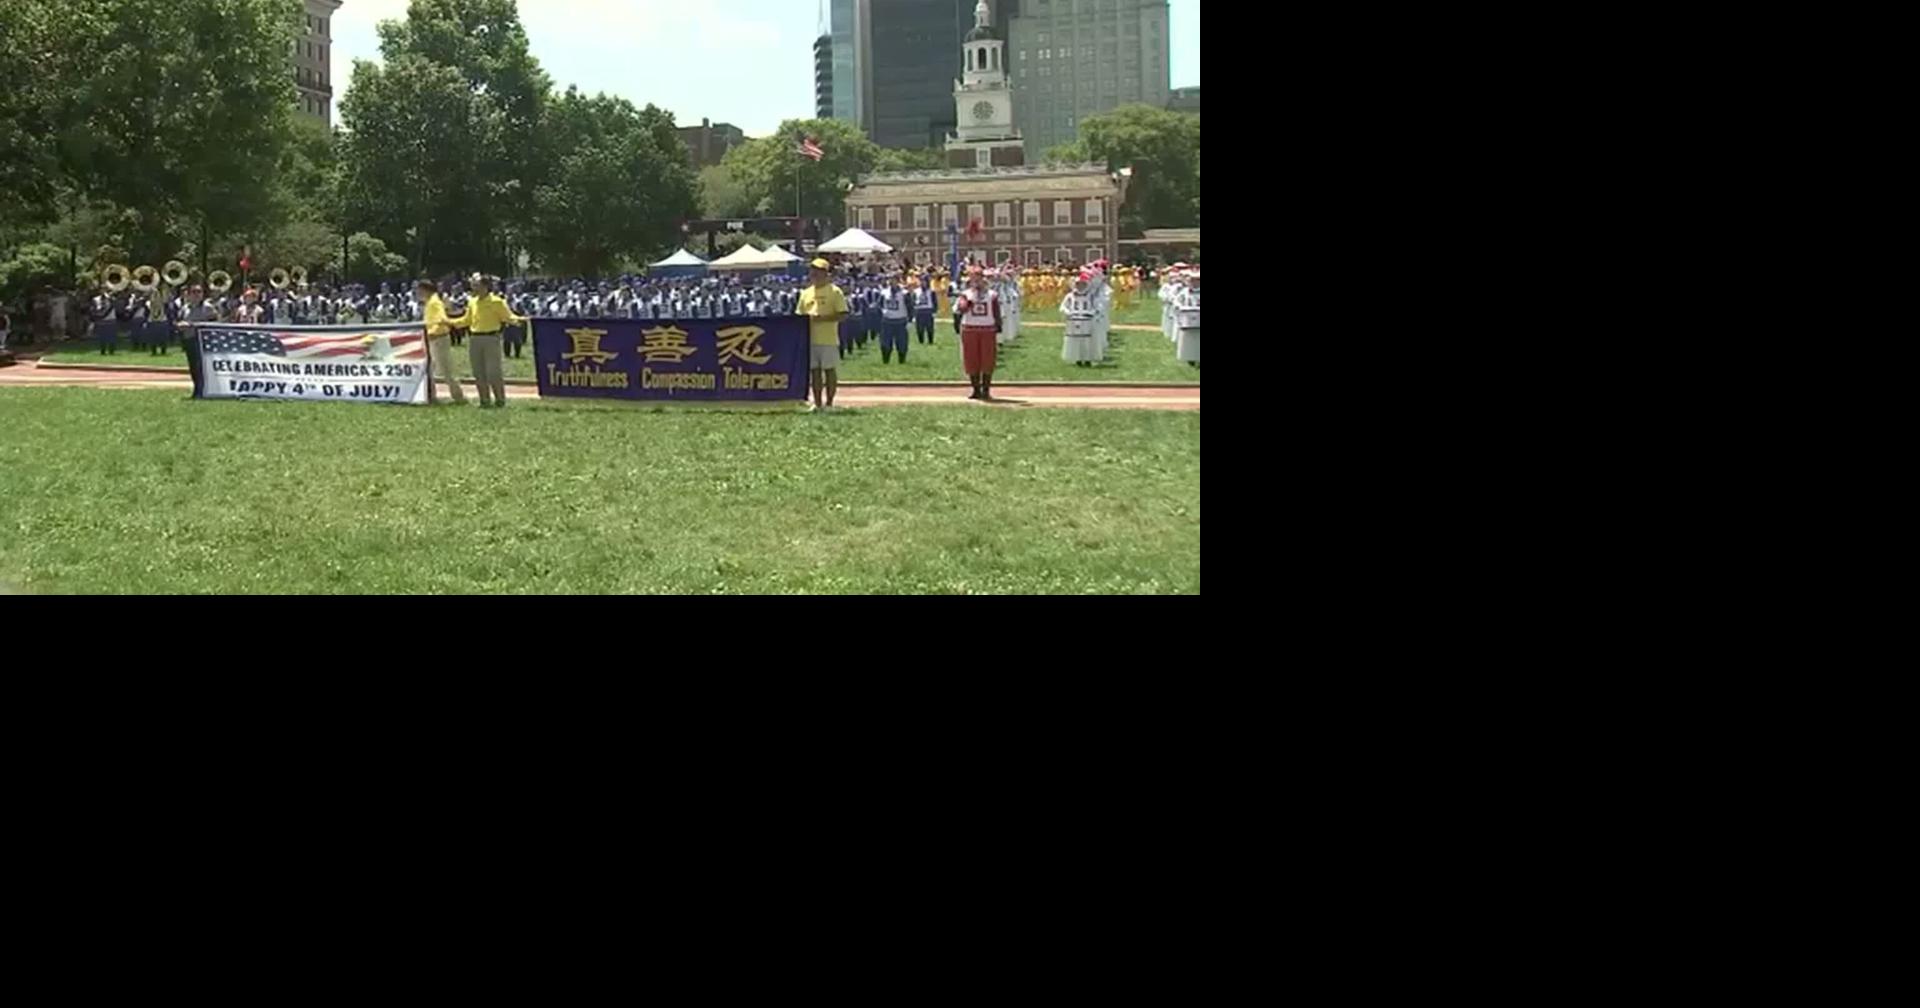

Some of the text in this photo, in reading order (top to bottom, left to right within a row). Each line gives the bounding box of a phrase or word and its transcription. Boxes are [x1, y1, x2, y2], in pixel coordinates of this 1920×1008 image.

[561, 324, 771, 366] 真善忍
[212, 359, 300, 375] CELEBRATING
[304, 363, 382, 377] AMERICA'S
[547, 363, 789, 394] Truthfulness Compassion Tolerance
[322, 384, 344, 397] OF
[349, 385, 401, 398] JULY!
